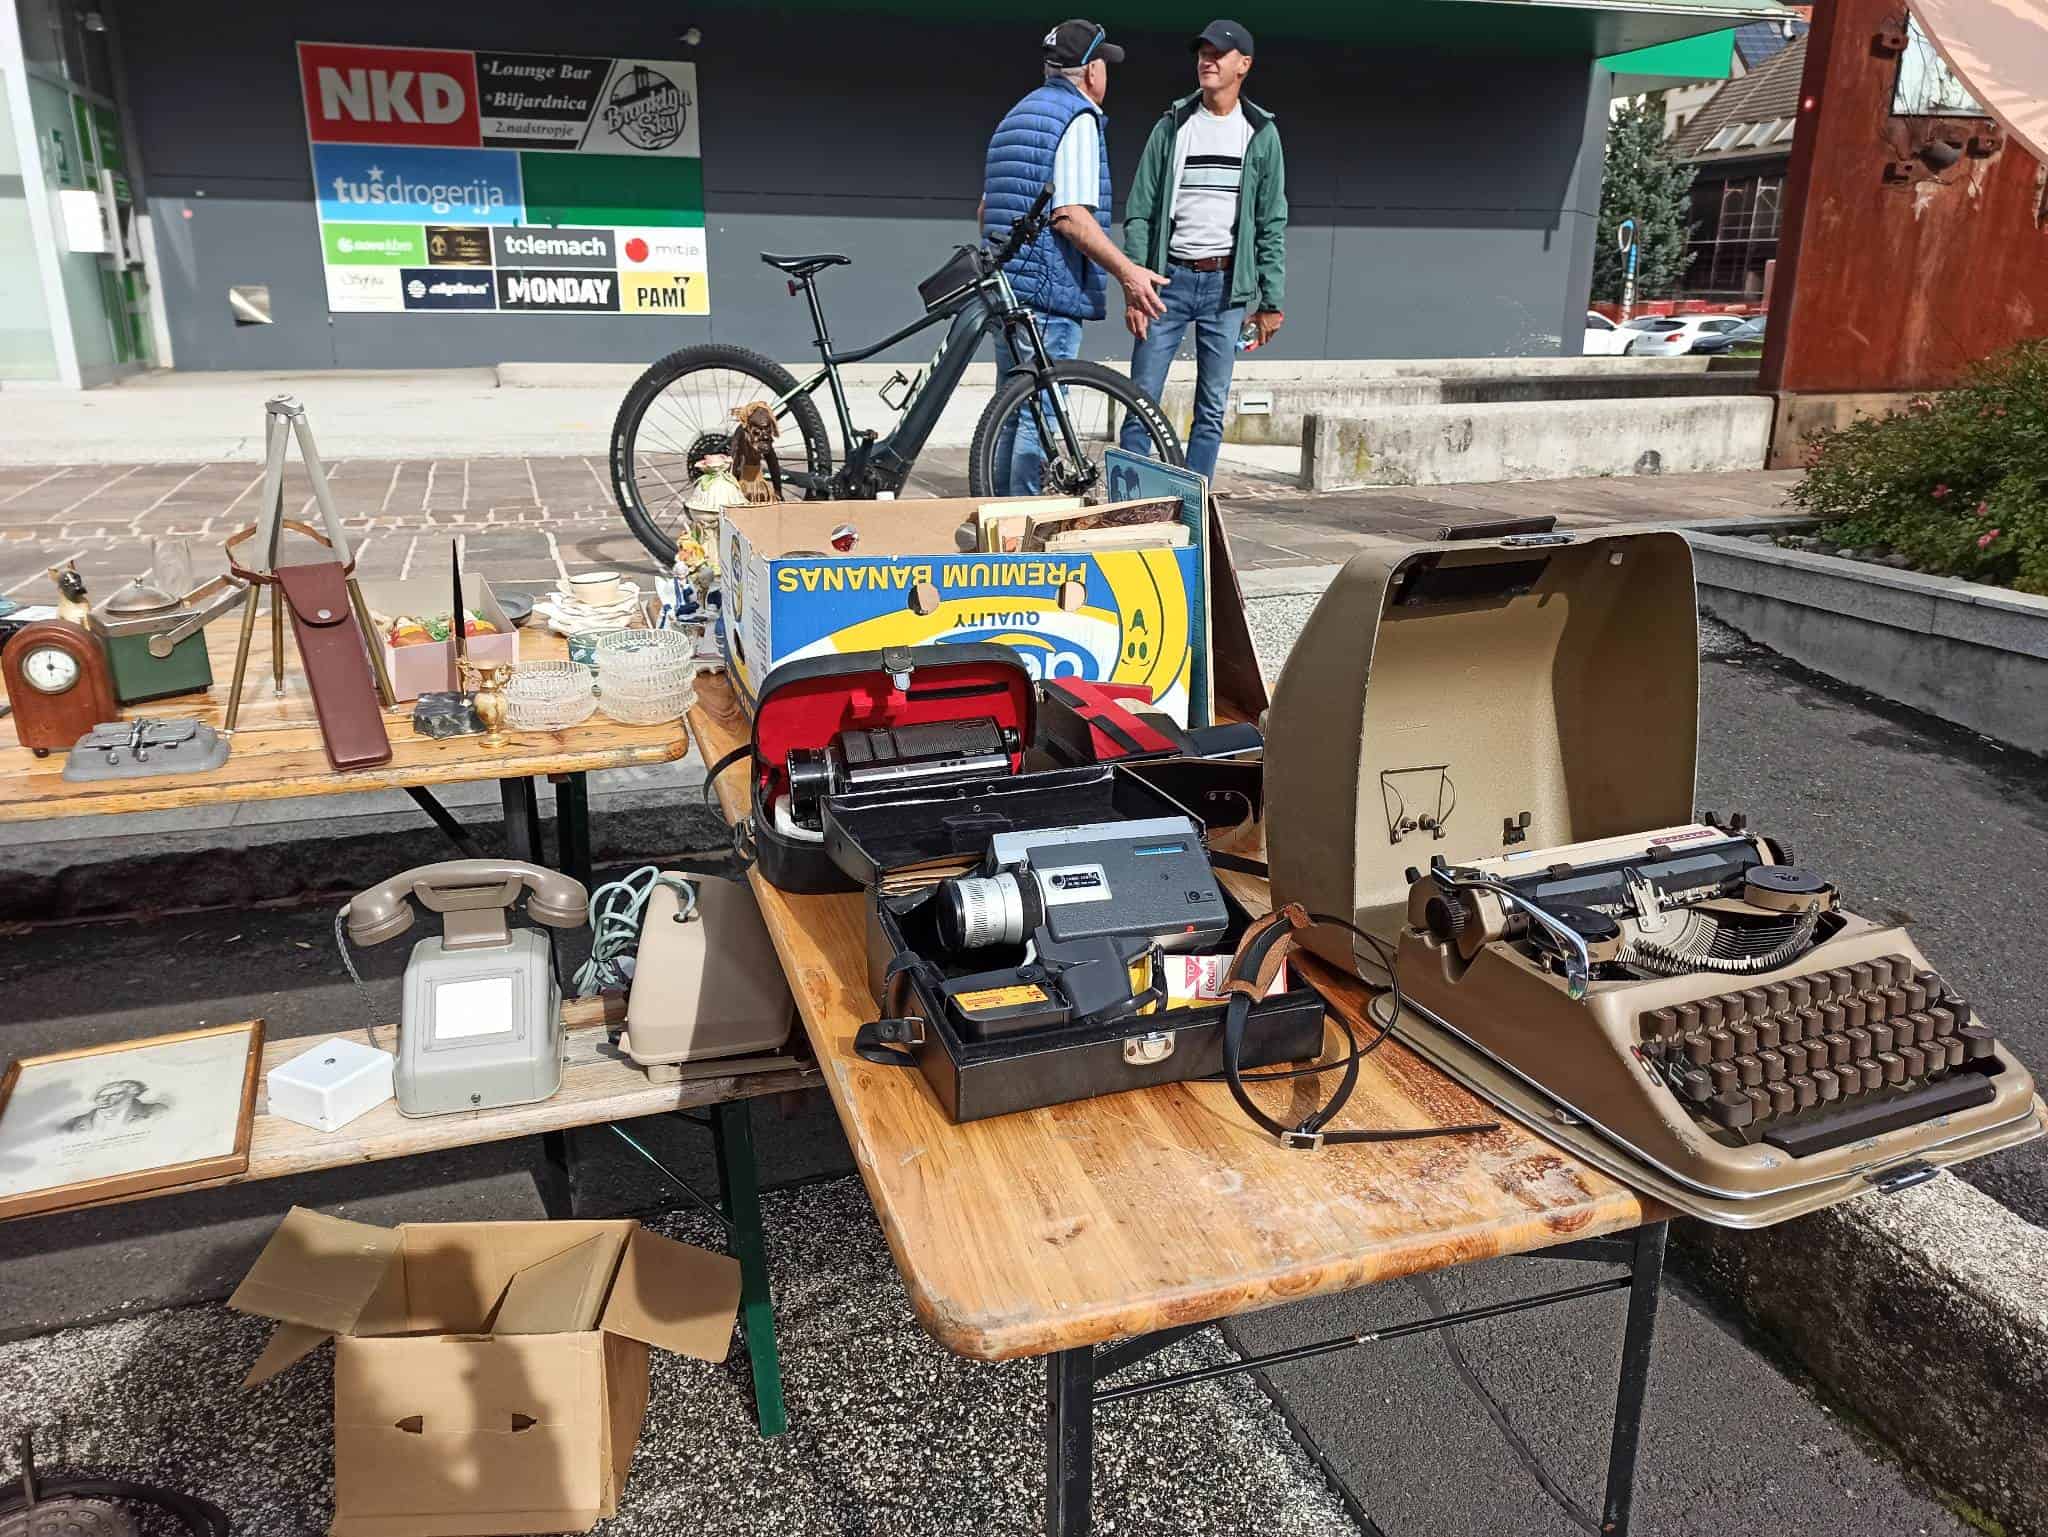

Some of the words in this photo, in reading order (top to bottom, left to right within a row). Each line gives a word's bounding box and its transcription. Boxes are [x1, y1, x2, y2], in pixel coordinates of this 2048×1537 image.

[490, 60, 555, 81] Lounge
[560, 65, 593, 80] Bar
[318, 66, 466, 124] NKD
[492, 92, 588, 111] Biljardnica
[504, 234, 607, 256] telemach
[655, 243, 699, 256] mitja
[506, 277, 611, 305] MONDAY
[777, 564, 933, 593] BANANAS
[942, 563, 1087, 588] PREMIUM
[953, 611, 1040, 627] QUALITY
[1205, 960, 1217, 992] Kodak
